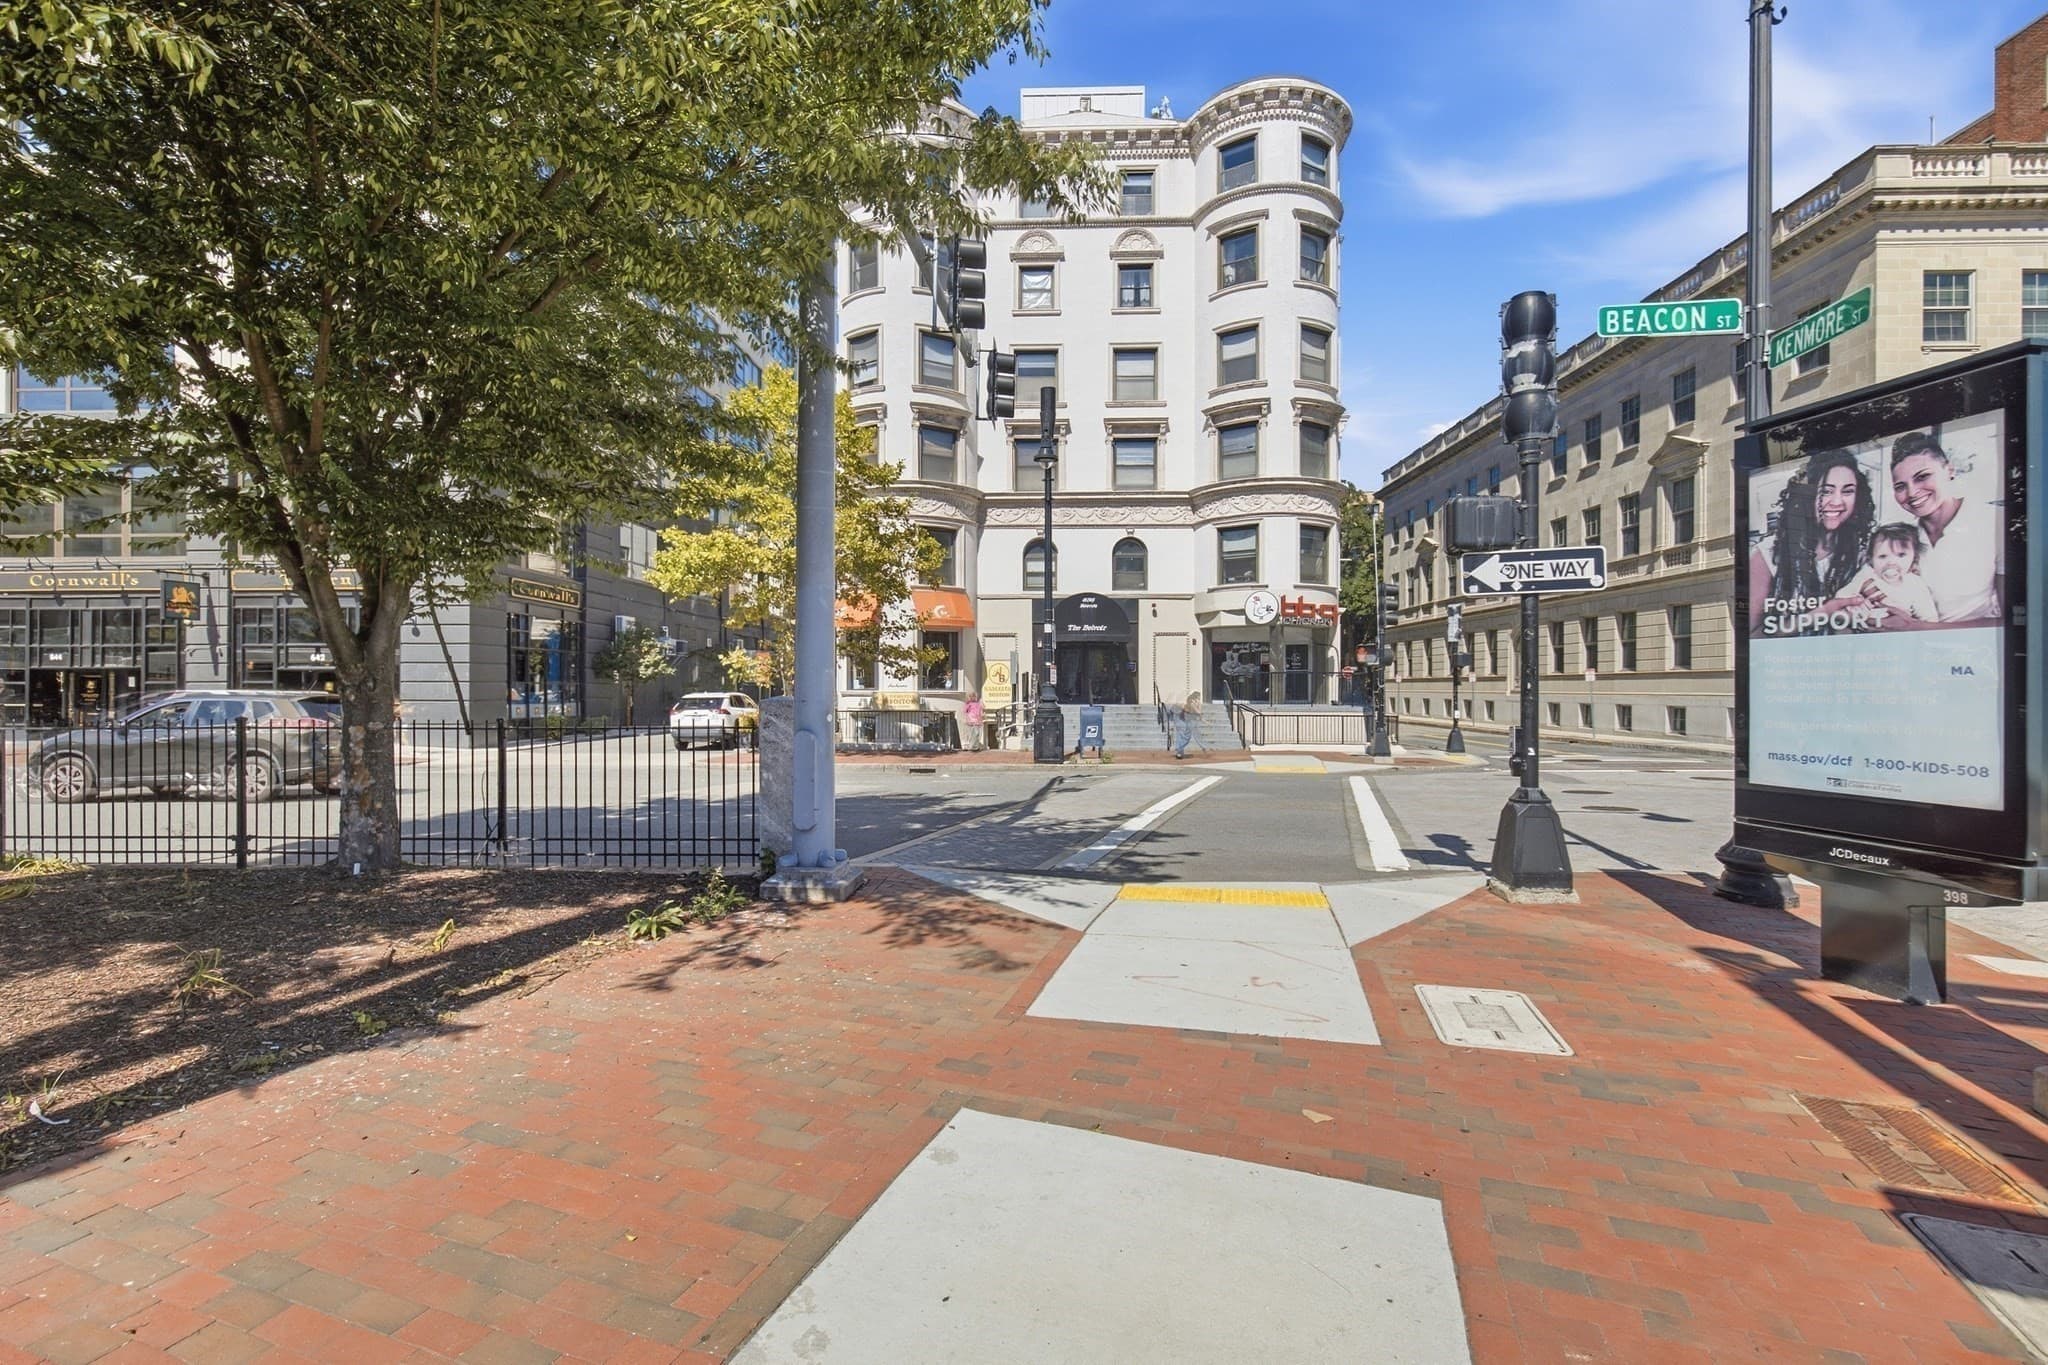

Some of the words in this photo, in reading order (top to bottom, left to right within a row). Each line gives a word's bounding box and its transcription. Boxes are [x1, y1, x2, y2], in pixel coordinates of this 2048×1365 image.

[1606, 305, 1706, 333] BEACON
[1716, 315, 1732, 328] ST
[1775, 304, 1846, 363] KENMORE
[1851, 305, 1868, 325] ST
[1505, 562, 1545, 579] ONE
[1550, 561, 1590, 577] WAY
[29, 573, 140, 587] Cornwall's
[1763, 595, 1827, 613] Foster
[1763, 608, 1889, 634] SUPPORT
[1950, 665, 1975, 676] MA
[1767, 750, 1853, 767] mass.gov/dcf
[1864, 757, 1990, 779] 1-800-KIDS-508
[1829, 847, 1890, 867] JCDecaux
[1943, 889, 1969, 905] 398
